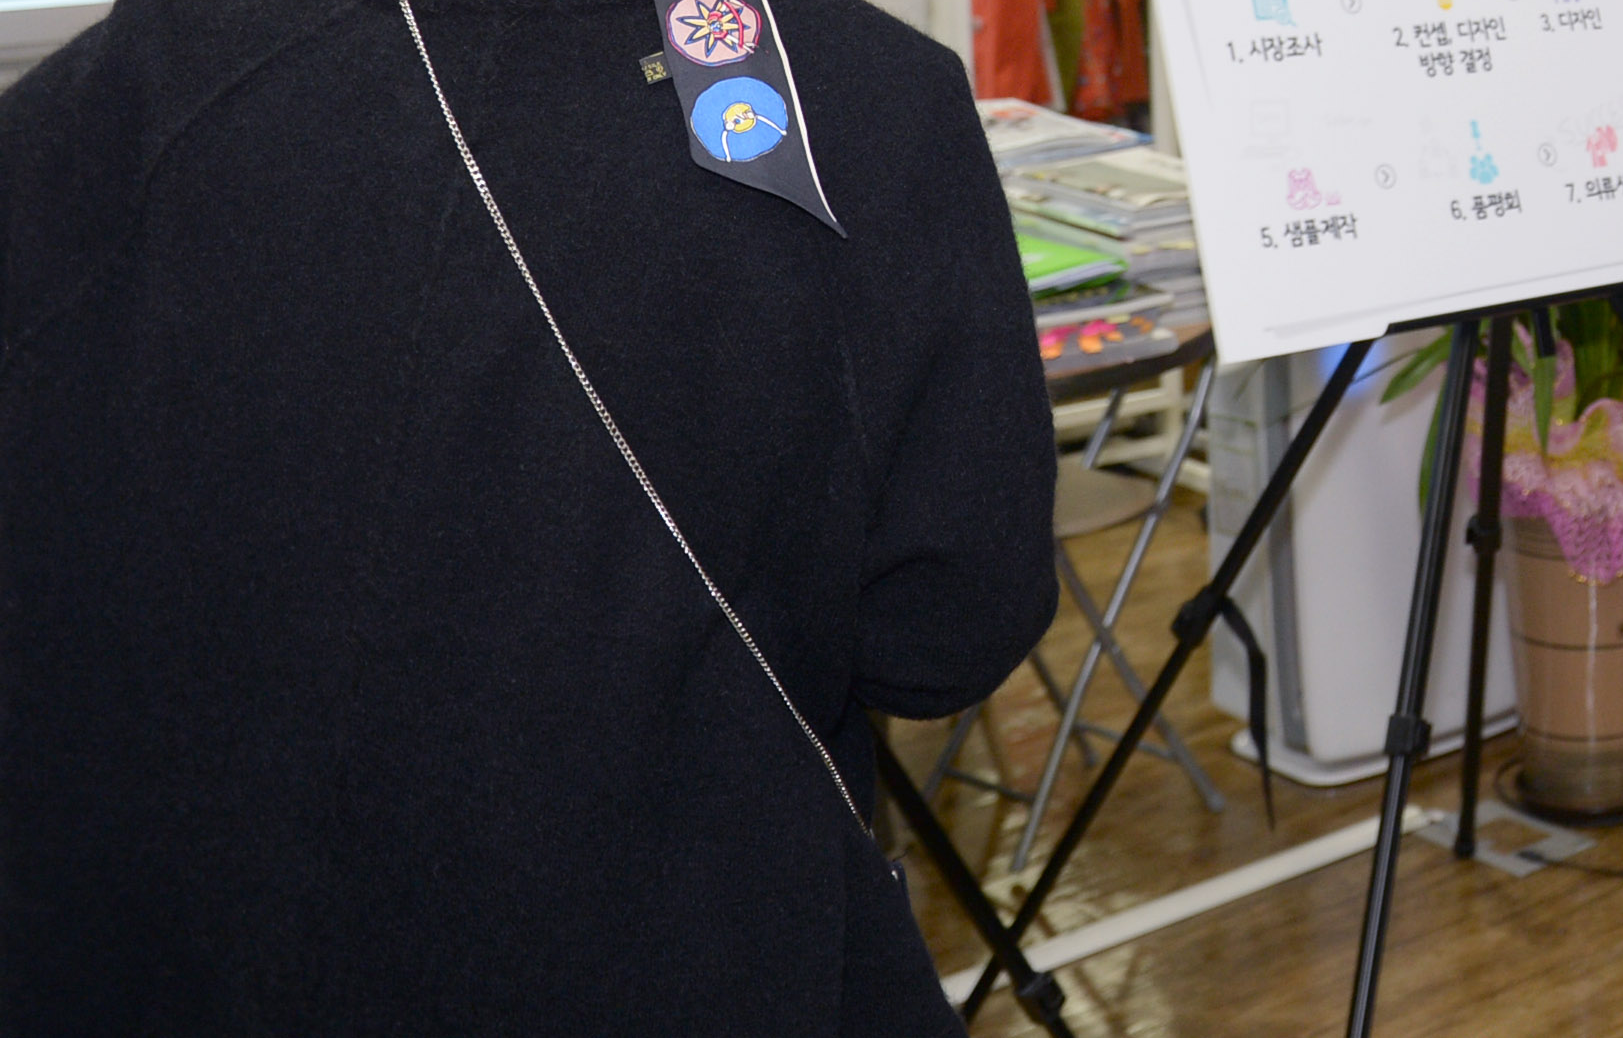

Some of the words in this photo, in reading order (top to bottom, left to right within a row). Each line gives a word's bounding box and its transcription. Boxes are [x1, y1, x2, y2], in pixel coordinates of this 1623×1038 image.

[1457, 15, 1506, 41] 디자인
[1540, 13, 1555, 32] 3.
[1557, 8, 1602, 31] 디자인
[1226, 40, 1244, 63] 1.
[1250, 32, 1323, 62] 시장조사
[1418, 50, 1454, 77] 방향
[1459, 47, 1493, 73] 결정
[1450, 199, 1467, 221] 6.
[1471, 188, 1523, 221] 품평회
[1564, 182, 1582, 203] 7.
[1260, 226, 1278, 249] 5.
[1284, 212, 1359, 248] 샘플제작
